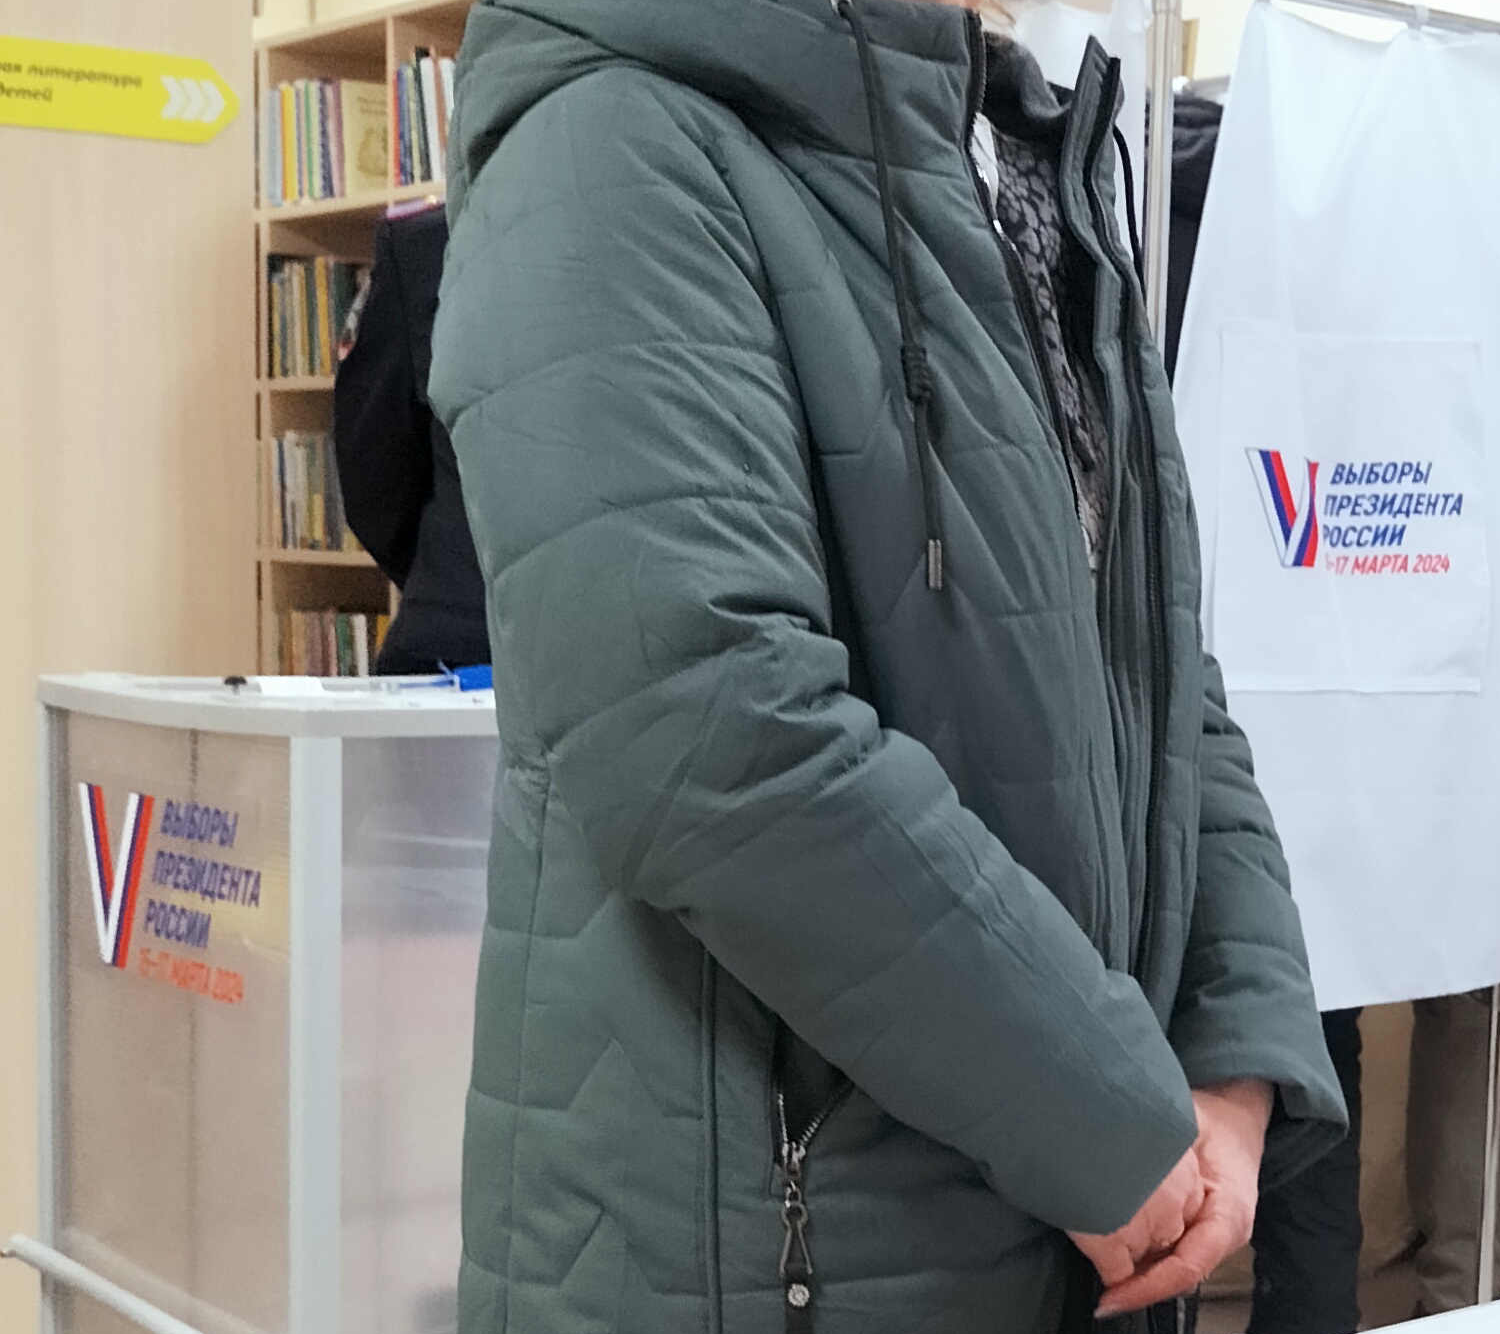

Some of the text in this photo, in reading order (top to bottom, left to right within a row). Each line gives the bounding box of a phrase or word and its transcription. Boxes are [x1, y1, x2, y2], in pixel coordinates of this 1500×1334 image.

[1330, 461, 1432, 485] ВЫБОРЫ
[1323, 493, 1463, 518] ПРЕЗИДЕНТА
[1351, 554, 1408, 576] МАРТА
[1412, 553, 1450, 574] 2024
[160, 798, 239, 849] ВЫБОРЫ
[151, 850, 262, 908] ПРЕЗИДЕНТА
[144, 898, 212, 949] РОССИИ
